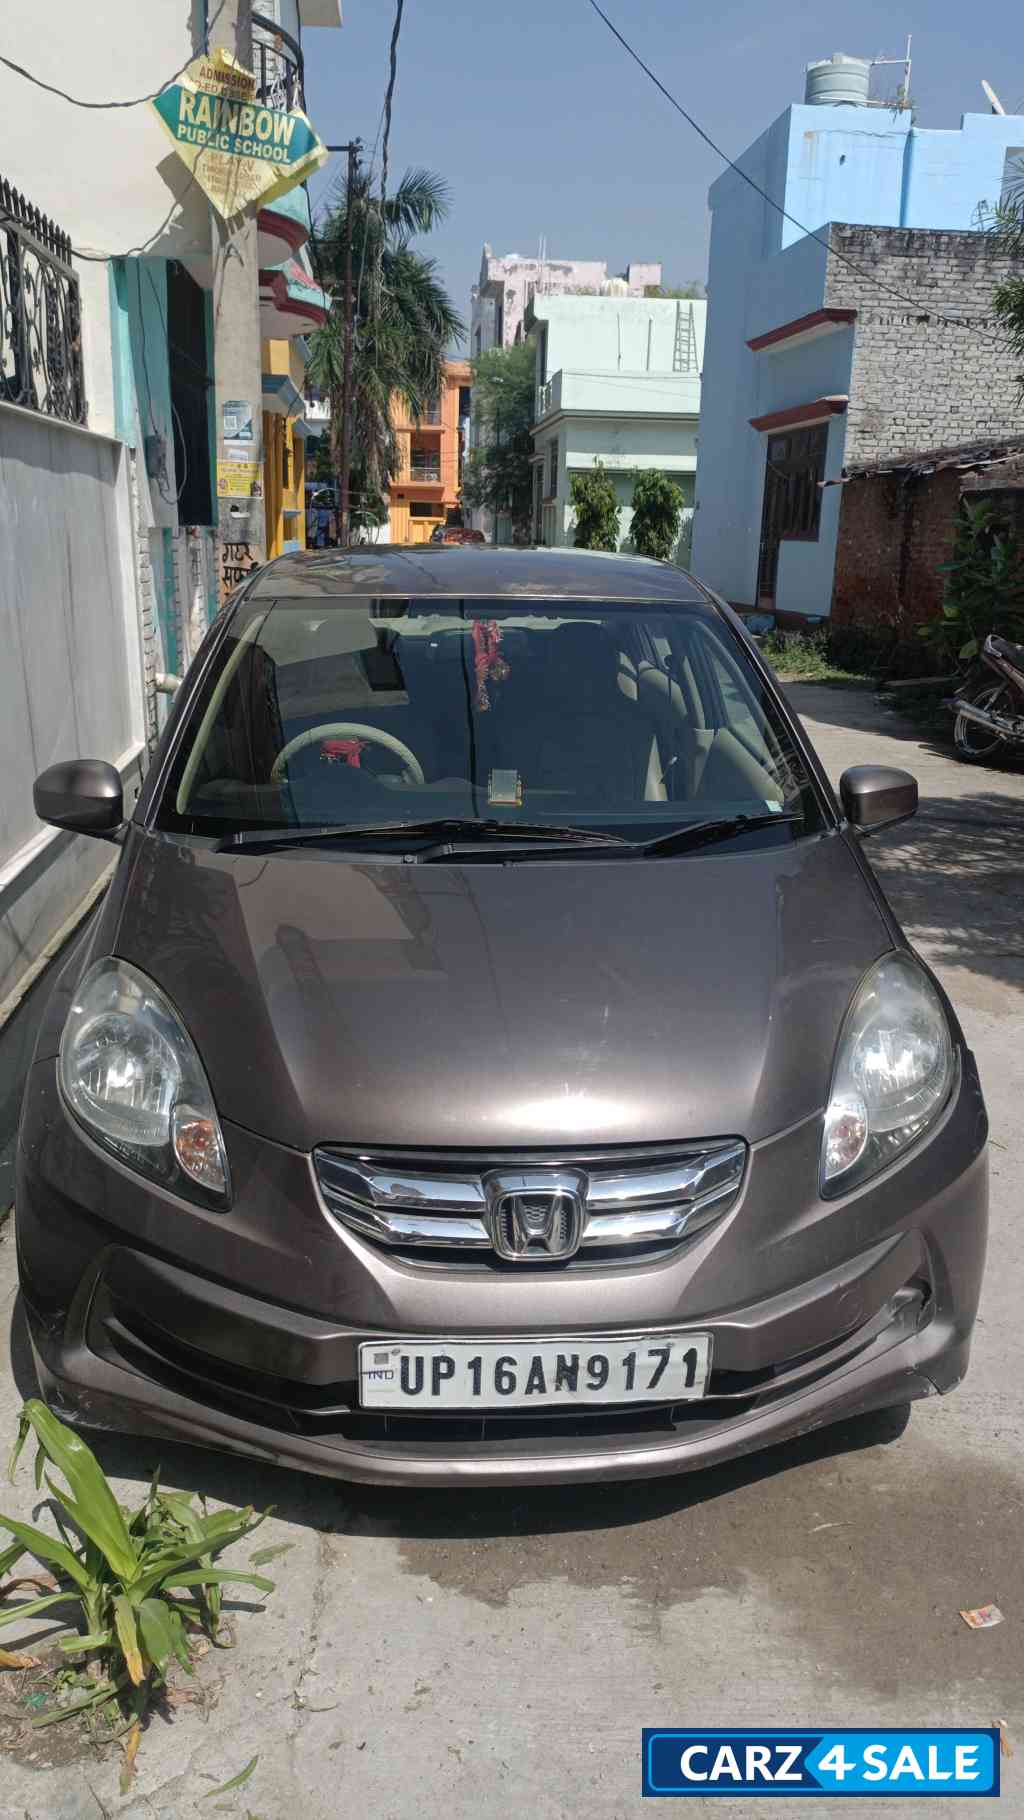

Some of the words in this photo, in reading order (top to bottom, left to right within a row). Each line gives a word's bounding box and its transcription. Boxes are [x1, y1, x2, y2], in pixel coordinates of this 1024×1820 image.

[199, 63, 256, 90] ADMISSION
[179, 88, 296, 146] RAINBOW
[177, 124, 230, 150] PUBLIC
[233, 137, 292, 163] SCHOOL
[367, 1370, 394, 1381] IND
[400, 1347, 698, 1396] UP16AN9171
